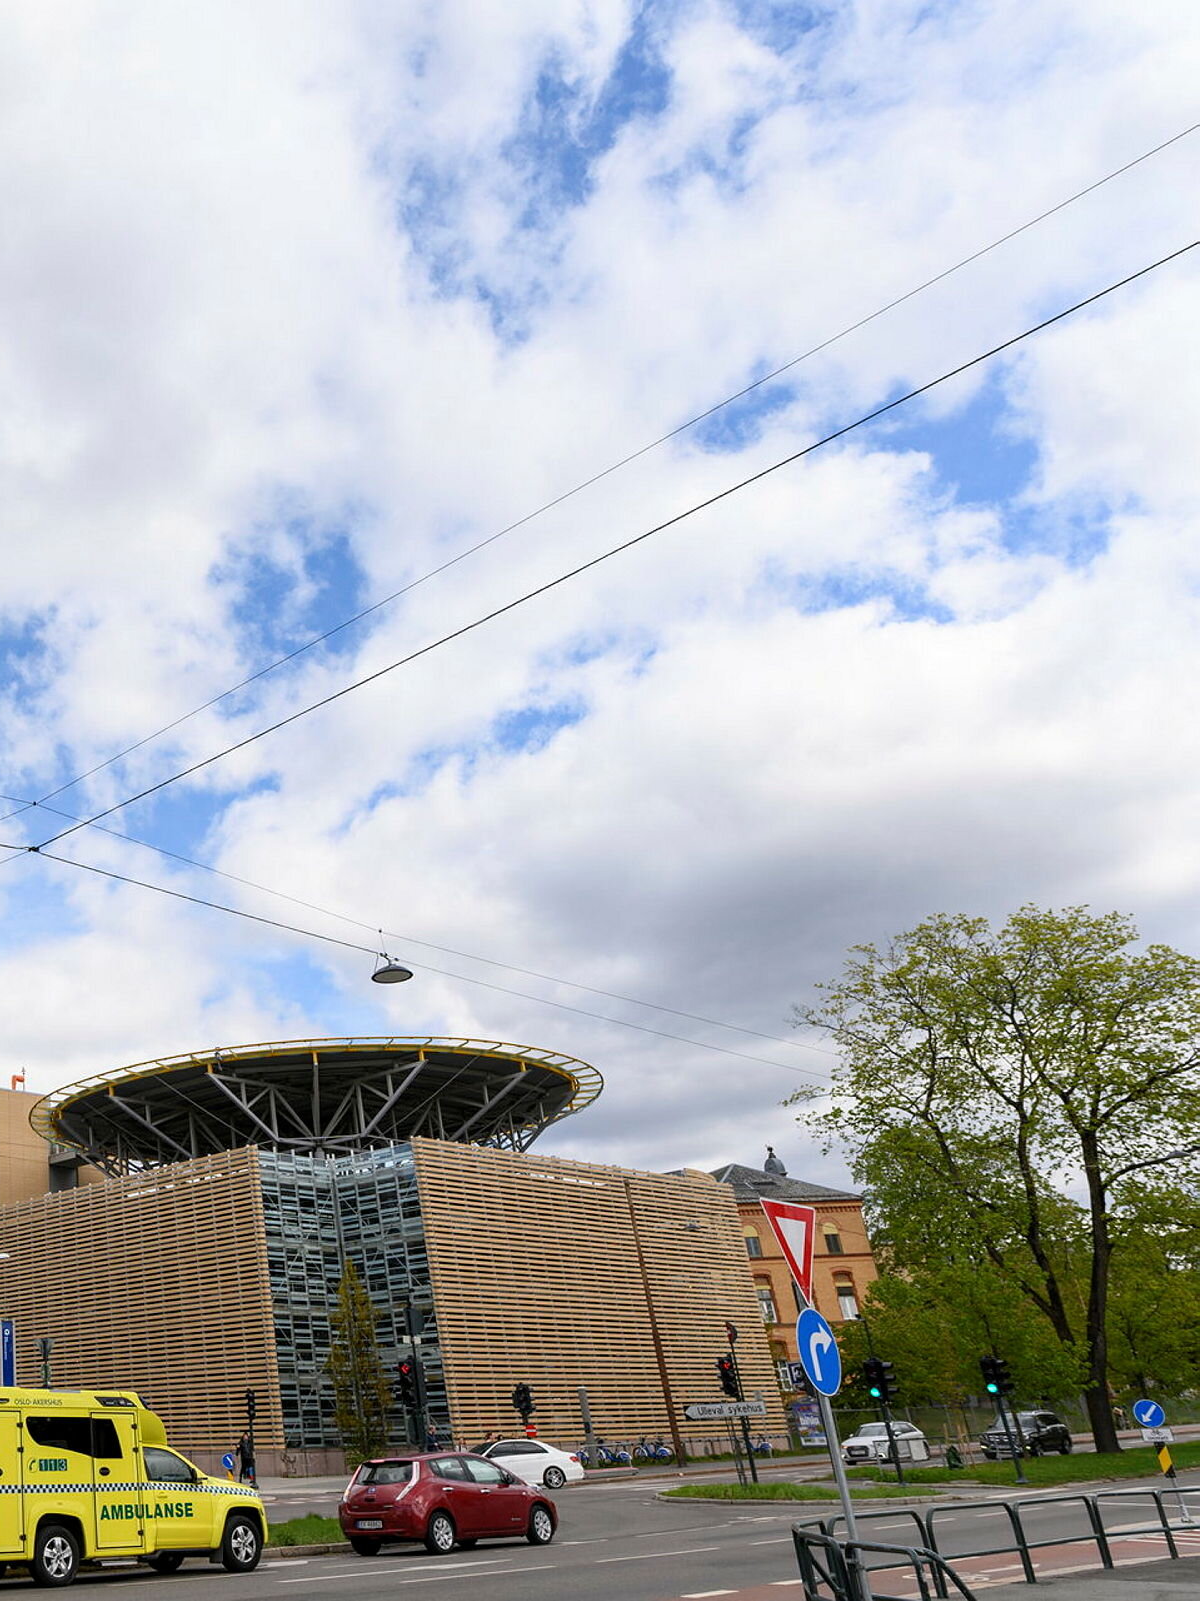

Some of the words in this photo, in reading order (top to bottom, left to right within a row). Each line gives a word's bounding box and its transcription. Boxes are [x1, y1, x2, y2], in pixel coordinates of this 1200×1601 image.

[728, 1404, 763, 1416] sykehus
[40, 1459, 67, 1471] 113
[100, 1502, 194, 1521] AMBULANSE
